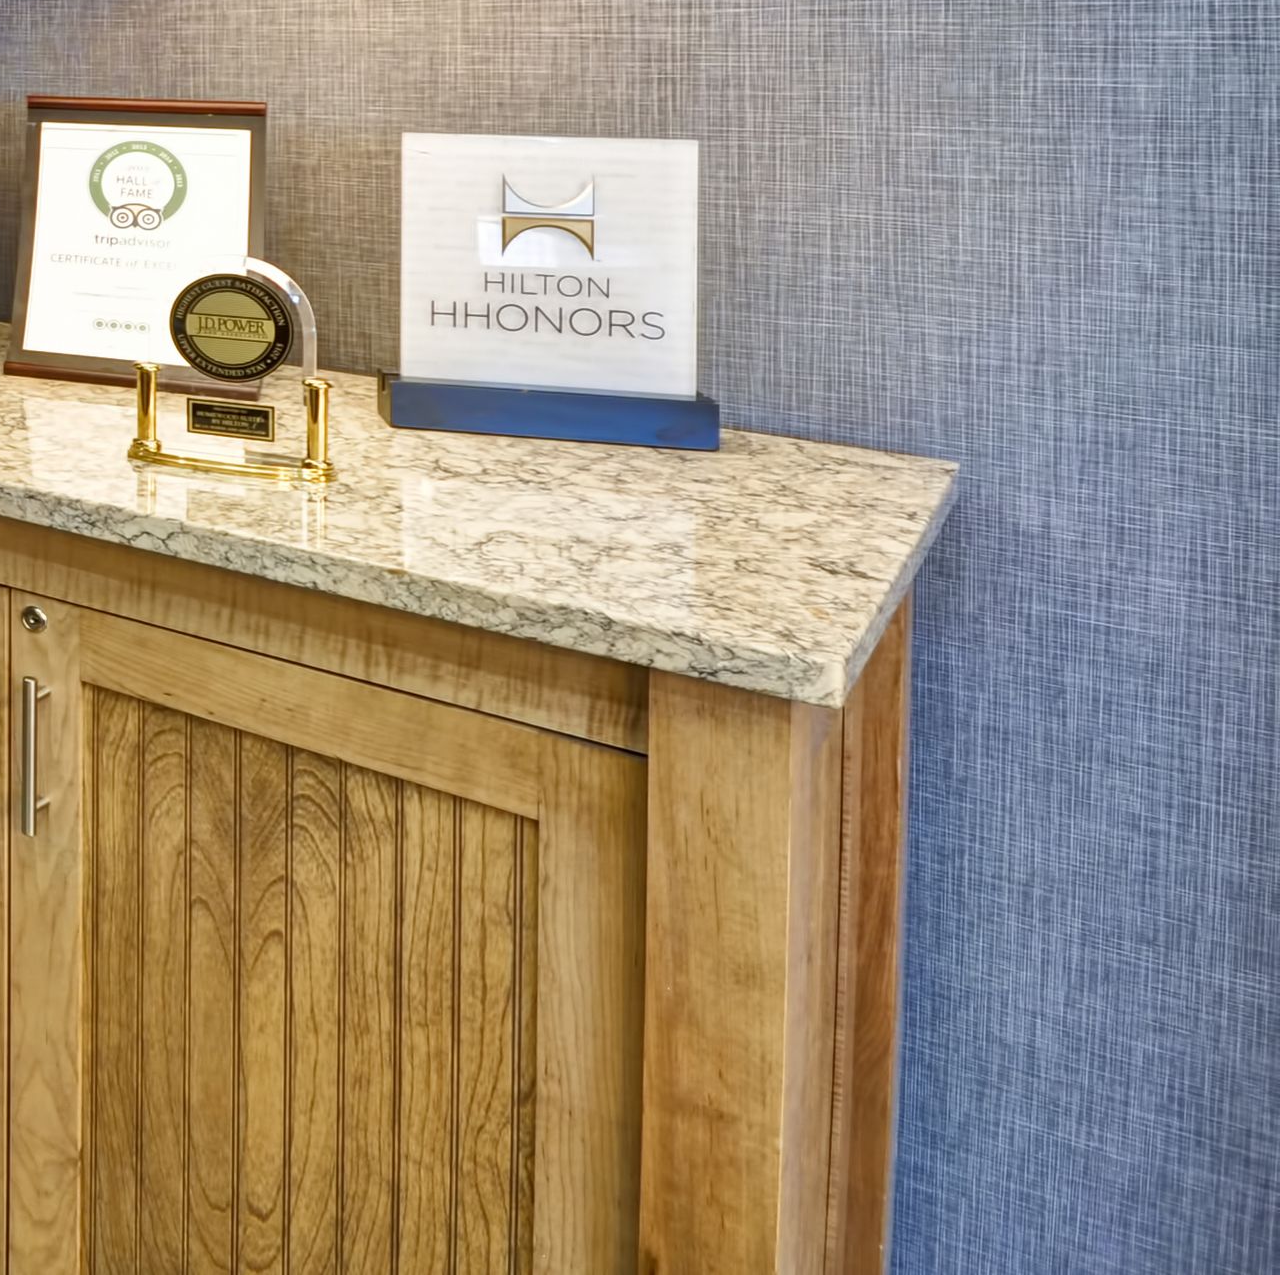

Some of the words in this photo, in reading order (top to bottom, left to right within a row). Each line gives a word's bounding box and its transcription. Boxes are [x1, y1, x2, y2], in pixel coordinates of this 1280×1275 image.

[116, 175, 148, 186] HALL
[120, 188, 154, 199] FAME
[95, 234, 171, 249] tripadvisor
[50, 253, 121, 268] CERTIFICATE
[484, 272, 610, 299] HILTON
[175, 287, 201, 319] HIGHEST
[201, 279, 233, 291] GUEST
[235, 281, 286, 326] SATISFACTION
[218, 318, 265, 333] POWER
[431, 300, 666, 341] HHONORS
[178, 334, 197, 360] UPPER
[195, 358, 245, 377] EXTENDED
[245, 363, 267, 375] STAY
